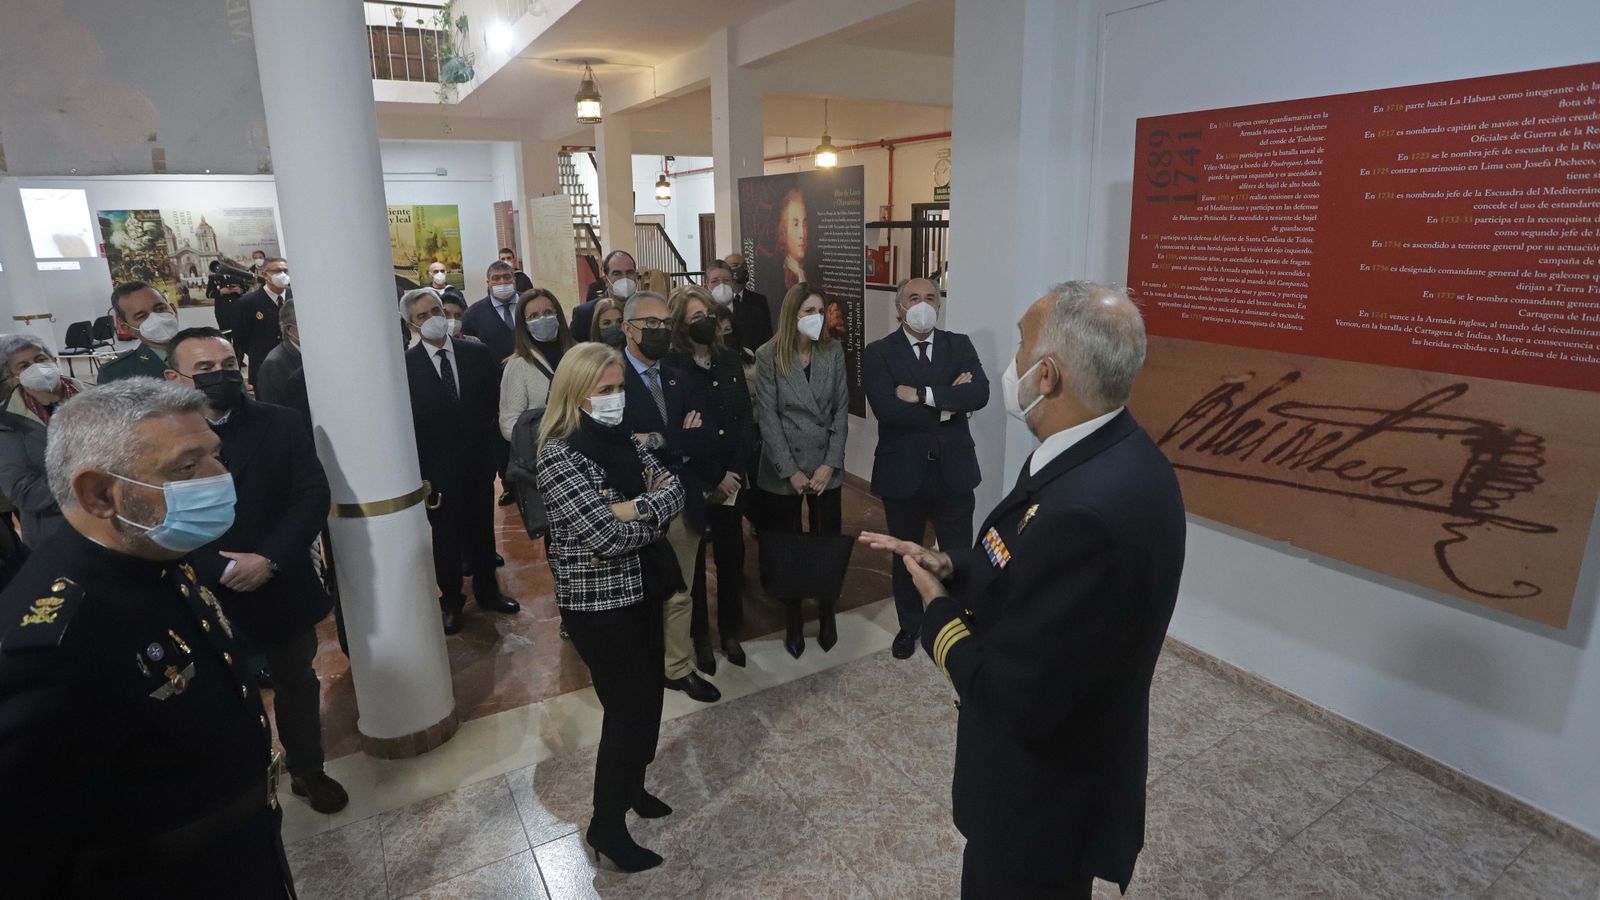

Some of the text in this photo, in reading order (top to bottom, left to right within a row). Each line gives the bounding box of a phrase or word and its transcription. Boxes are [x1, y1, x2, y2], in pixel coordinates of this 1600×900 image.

[1374, 104, 1383, 112] En
[1405, 101, 1424, 112] parte
[1427, 97, 1447, 107] hacia
[1449, 96, 1460, 105] La
[1463, 93, 1496, 104] Habana
[1498, 92, 1523, 100] como
[1525, 86, 1573, 98] integrante
[1576, 83, 1588, 92] de
[1558, 96, 1595, 108] flota de
[1240, 128, 1261, 137] Armada
[1303, 123, 1327, 132] órdenes
[1365, 130, 1375, 138] En
[1405, 124, 1445, 135] nombrado
[1447, 121, 1476, 133] capitán
[1478, 120, 1489, 129] de
[1491, 117, 1519, 128] navíos
[1521, 115, 1535, 125] del
[1538, 113, 1566, 124] recién
[1270, 137, 1287, 145] conde
[1297, 134, 1325, 143] Toulouse.
[1471, 132, 1507, 143] Oficiales
[1510, 130, 1521, 140] de
[1523, 129, 1556, 139] Guerra
[1559, 126, 1571, 136] de
[1574, 125, 1582, 135] la
[1398, 152, 1408, 161] En
[1441, 149, 1448, 158] le
[1450, 147, 1481, 158] nombra
[1484, 146, 1499, 158] jefe
[1502, 145, 1512, 154] de
[1515, 143, 1553, 154] escuadra
[1556, 141, 1568, 151] de
[1571, 140, 1579, 150] la
[1360, 167, 1370, 176] En
[1420, 162, 1466, 173] matrimonio
[1481, 160, 1503, 170] Lima
[1524, 157, 1551, 170] Josefa
[1554, 156, 1596, 166] Pacheco,
[1365, 191, 1375, 199] En
[1405, 189, 1444, 198] nombrado
[1446, 188, 1460, 200] jefe
[1462, 188, 1472, 197] de
[1475, 188, 1481, 197] la
[1485, 187, 1523, 197] Escuadra
[1526, 186, 1540, 196] del
[1473, 200, 1507, 210] concede
[1509, 200, 1517, 209] el
[1537, 199, 1548, 209] de
[1551, 198, 1600, 209] estandarte
[1427, 215, 1438, 224] En
[1474, 214, 1511, 226] participa
[1527, 214, 1535, 223] la
[1537, 213, 1591, 226] reconquista
[1521, 227, 1558, 239] segundo
[1561, 227, 1578, 239] jefe
[1581, 227, 1592, 237] de
[1372, 239, 1382, 248] En
[1412, 240, 1449, 249] ascendido
[1458, 240, 1490, 249] teniente
[1493, 240, 1524, 252] general
[1526, 243, 1542, 252] por
[1360, 262, 1370, 271] En
[1399, 264, 1436, 275] designado
[1438, 266, 1486, 276] comandante
[1488, 268, 1519, 278] general
[1521, 268, 1532, 277] de
[1534, 268, 1547, 278] los
[1549, 269, 1590, 281] galeones
[1516, 281, 1544, 293] dirijan
[1557, 282, 1584, 293] Tierra
[1359, 309, 1369, 318] En
[1417, 313, 1423, 322] la
[1425, 314, 1456, 325] Armada
[1458, 316, 1487, 328] inglesa,
[1490, 319, 1497, 328] al
[1499, 321, 1529, 331] mando
[1531, 322, 1545, 332] del
[1518, 307, 1564, 321] Cartagena
[1567, 310, 1578, 320] de
[1412, 336, 1421, 346] las
[1423, 337, 1450, 348] heridas
[1452, 341, 1487, 352] recibidas
[1501, 344, 1508, 354] la
[1511, 345, 1543, 358] defensa
[1546, 349, 1557, 359] de
[1560, 350, 1567, 360] la
